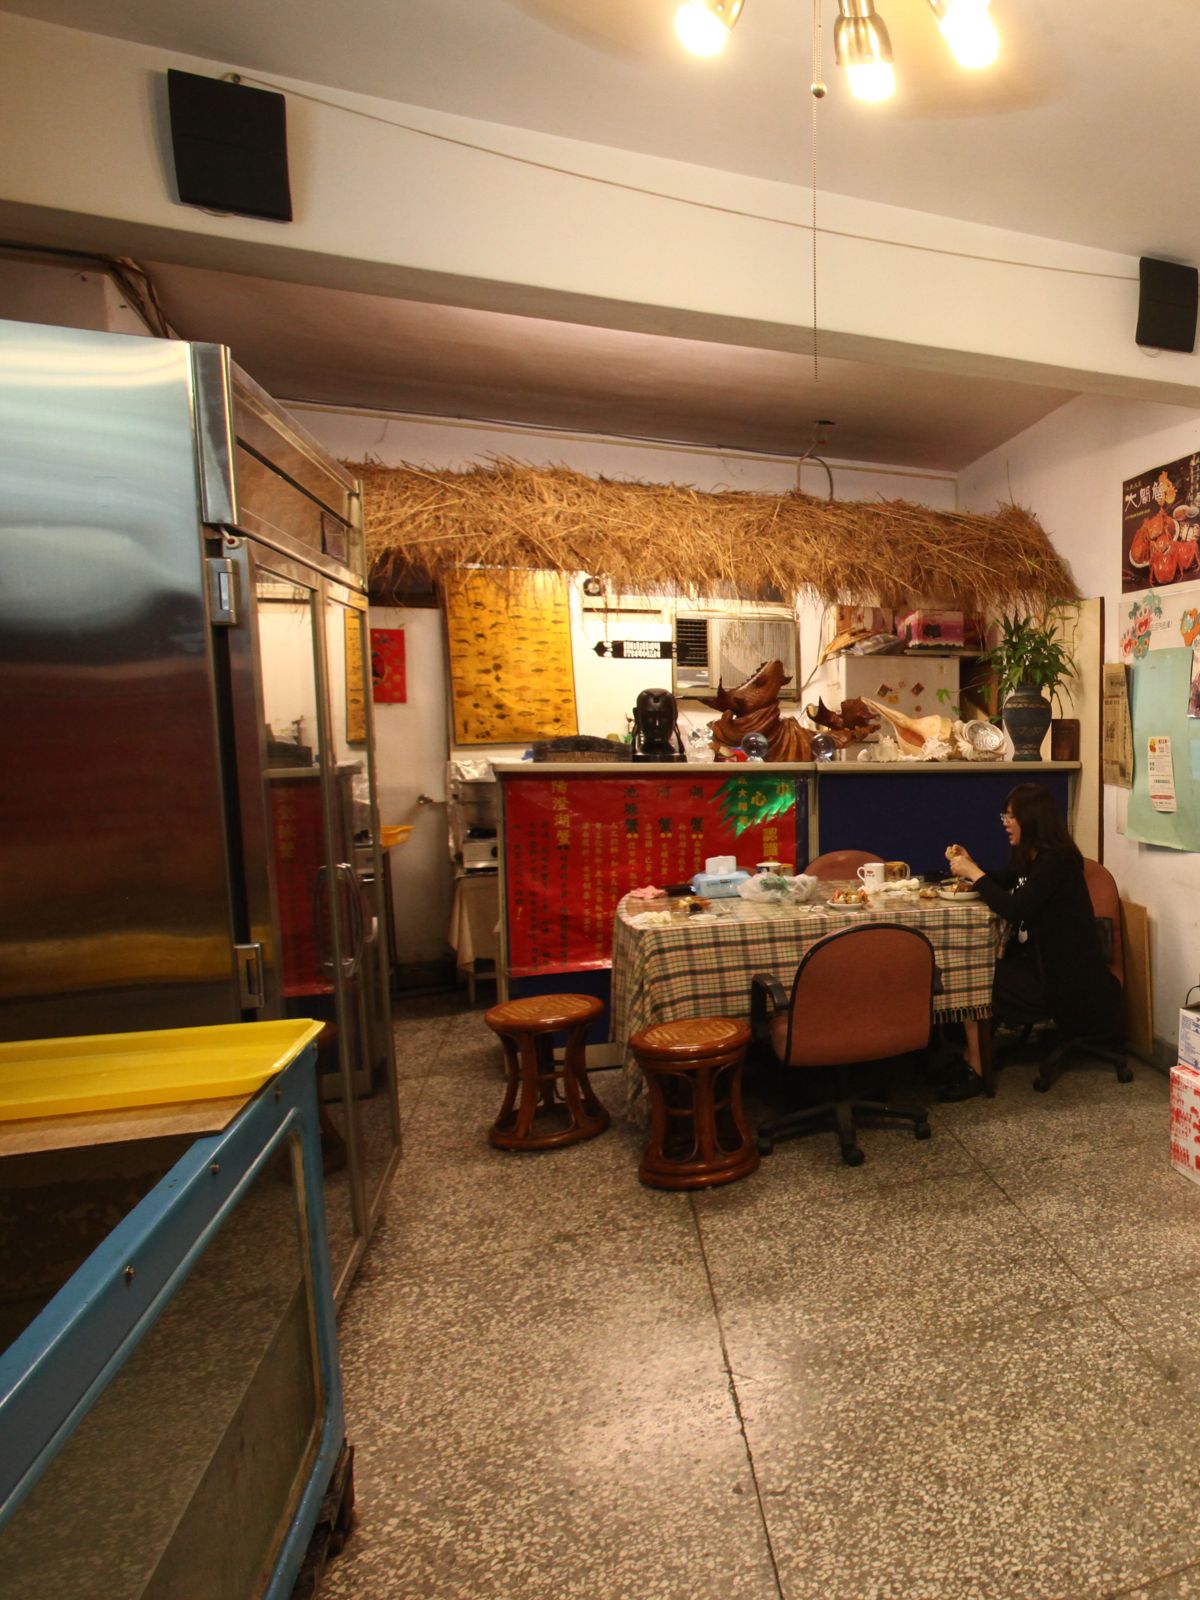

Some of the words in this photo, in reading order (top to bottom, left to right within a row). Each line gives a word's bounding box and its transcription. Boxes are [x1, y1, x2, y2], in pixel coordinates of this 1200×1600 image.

[552, 780, 571, 845] 陽澄湖蟹
[762, 827, 778, 862] 認識
